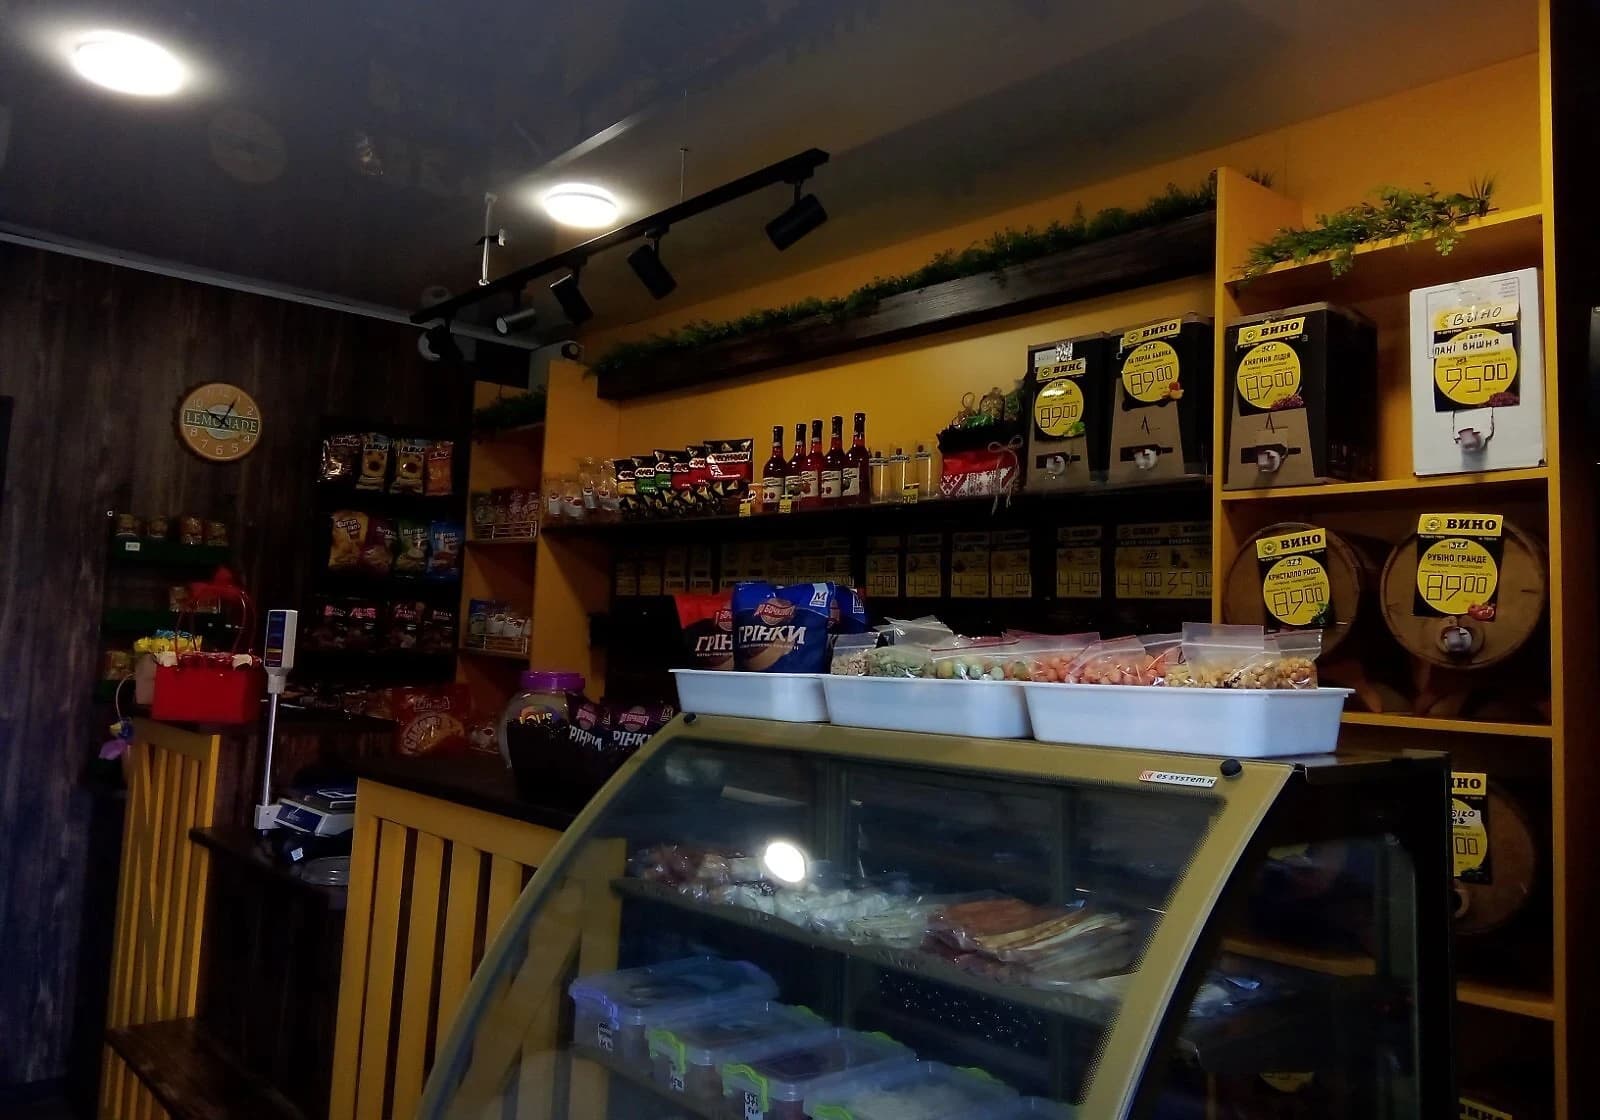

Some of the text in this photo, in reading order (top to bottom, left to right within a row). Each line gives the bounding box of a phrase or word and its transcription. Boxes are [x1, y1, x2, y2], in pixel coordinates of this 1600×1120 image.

[1142, 323, 1177, 338] ВИНО
[1260, 322, 1299, 337] ВИНО
[1434, 338, 1499, 356] ПАНІ ВИШНЯ
[1446, 519, 1497, 530] ВИНО
[1281, 534, 1321, 549] ВИНО
[1427, 553, 1487, 564] РУБІНО ГРАНДЕ
[695, 634, 733, 652] ГРІН
